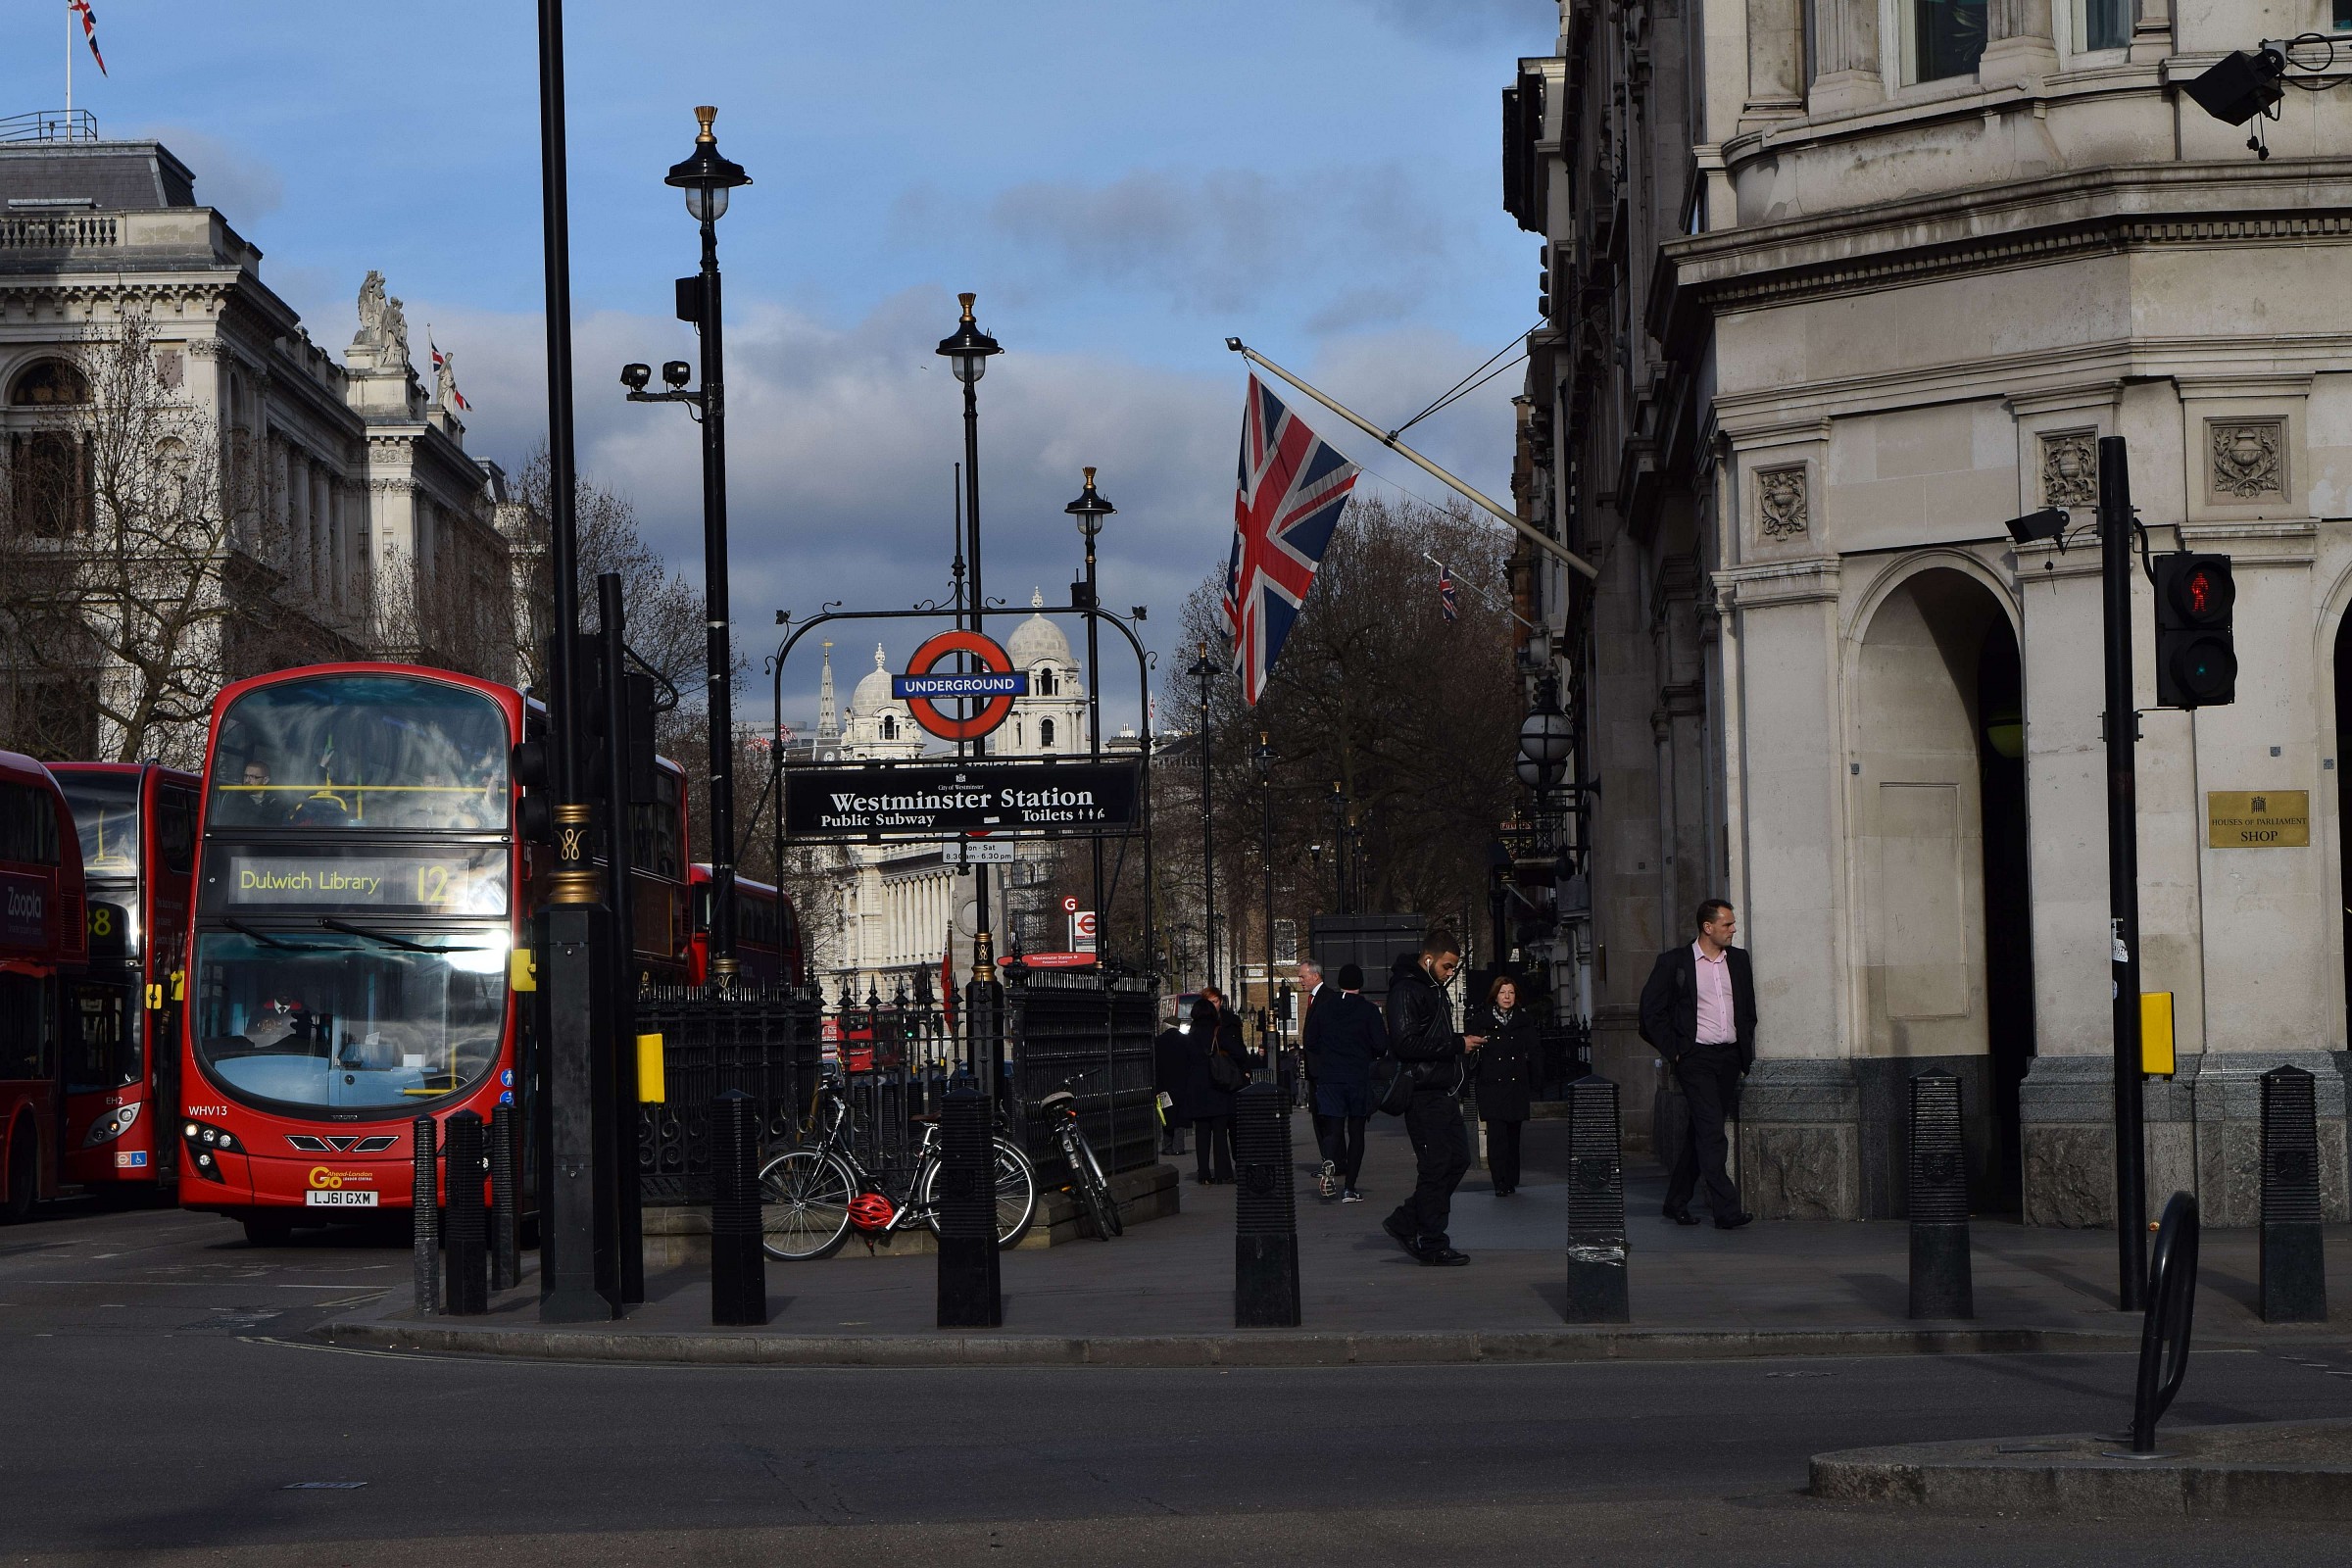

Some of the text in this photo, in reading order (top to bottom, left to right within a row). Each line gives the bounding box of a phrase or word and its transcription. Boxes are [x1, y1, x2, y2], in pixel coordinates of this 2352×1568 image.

[905, 678, 1014, 692] UNDERGROUND
[830, 787, 1095, 812] Westminster Station
[820, 812, 936, 828] Public Subway
[1021, 808, 1074, 822] Toilets
[2257, 817, 2307, 826] PARLIAMENT
[2240, 830, 2278, 842] SHOP
[240, 870, 380, 895] Dulwich Library
[417, 864, 449, 902] 12
[7, 886, 42, 924] Zoopla
[1064, 898, 1076, 910] G
[106, 1097, 123, 1105] EH2
[188, 1105, 227, 1116] WHV13
[309, 1166, 342, 1189] Go
[315, 1192, 370, 1204] LJ61 GXM
